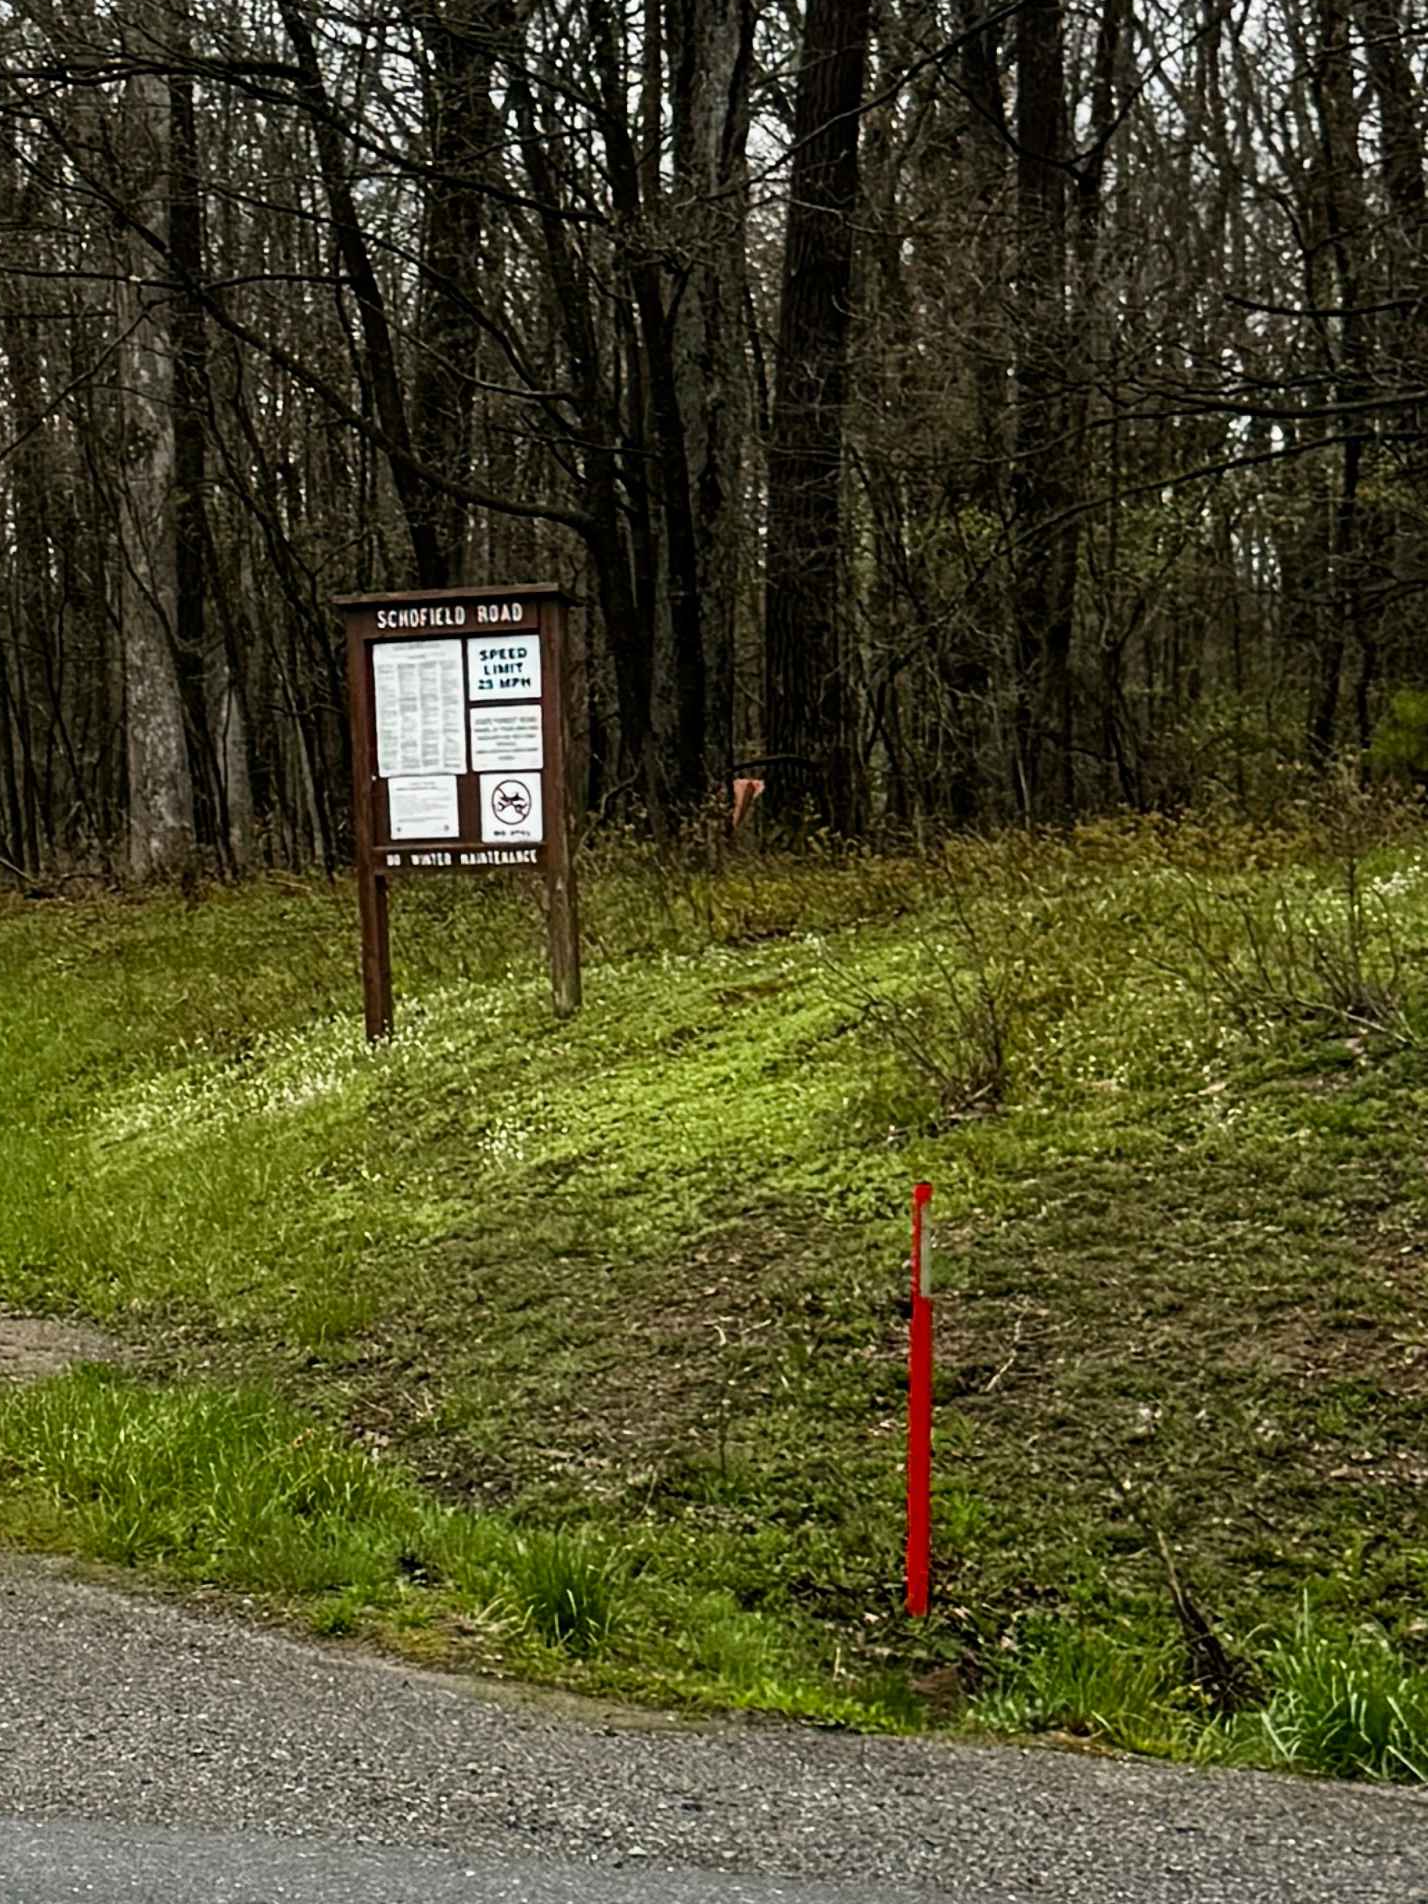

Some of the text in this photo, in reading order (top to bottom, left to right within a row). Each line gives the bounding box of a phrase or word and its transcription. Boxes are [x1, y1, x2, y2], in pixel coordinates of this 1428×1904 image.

[376, 602, 523, 628] SCHOFIELD ROAD
[479, 647, 528, 661] SPEED
[484, 662, 523, 675] LIMIT
[499, 677, 531, 689] MPH
[410, 852, 452, 866] WINTER
[460, 849, 538, 865] MAINTENANCE
